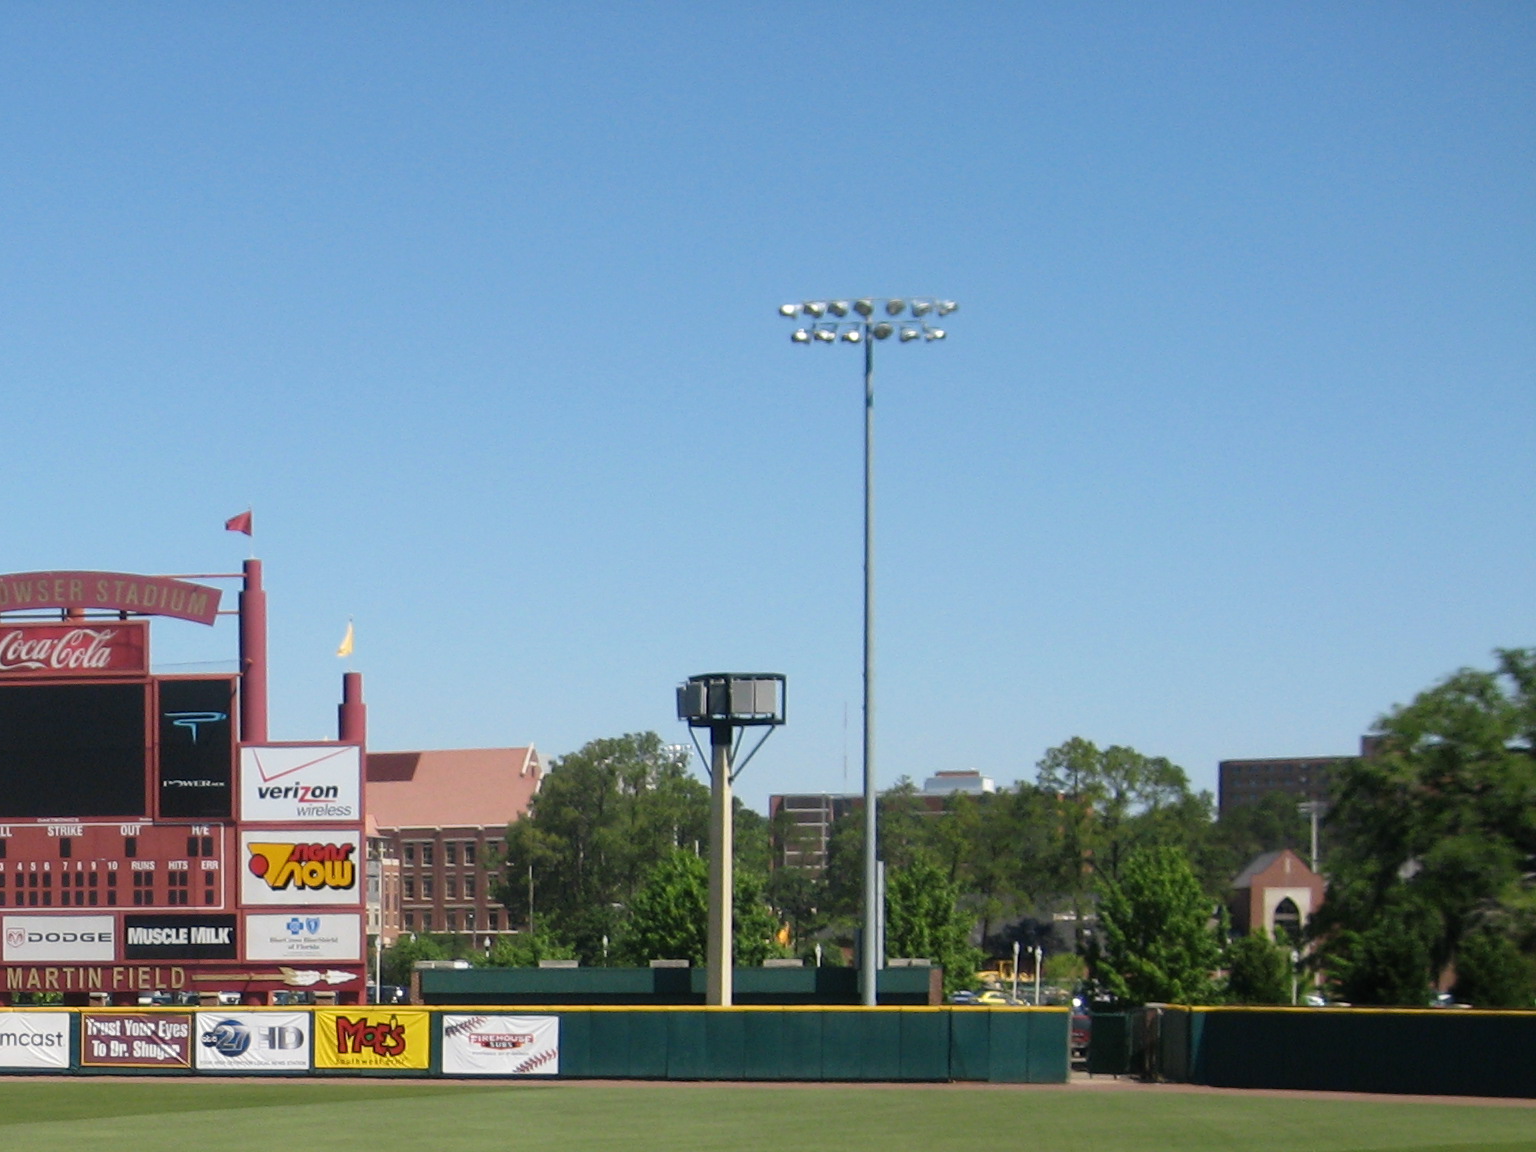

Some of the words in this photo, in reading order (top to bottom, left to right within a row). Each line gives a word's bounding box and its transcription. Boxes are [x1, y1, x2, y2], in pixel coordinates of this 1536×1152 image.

[95, 578, 210, 616] STADIUM
[258, 782, 339, 803] verizon
[296, 802, 352, 818] wireless
[47, 825, 84, 837] STRIKE
[120, 824, 142, 836] OUT
[16, 862, 24, 871] 4
[30, 861, 38, 870] 5
[43, 861, 51, 871] 6
[62, 861, 69, 870] 7
[76, 861, 83, 870] 8
[91, 861, 98, 870] 9
[107, 861, 119, 871] 10
[131, 861, 156, 870] RUNS
[168, 860, 189, 870] HITS
[201, 860, 219, 870] ERR
[27, 931, 112, 943] DODGE
[6, 967, 103, 989] MARTIN
[112, 966, 186, 989] FIELD
[85, 1018, 121, 1036] Trust
[158, 1019, 189, 1040] Eyes
[214, 1025, 251, 1051] 27
[259, 1026, 305, 1050] HD
[469, 1033, 534, 1044] FIREHOUSE
[92, 1039, 108, 1057] To
[110, 1039, 130, 1057] Dr.
